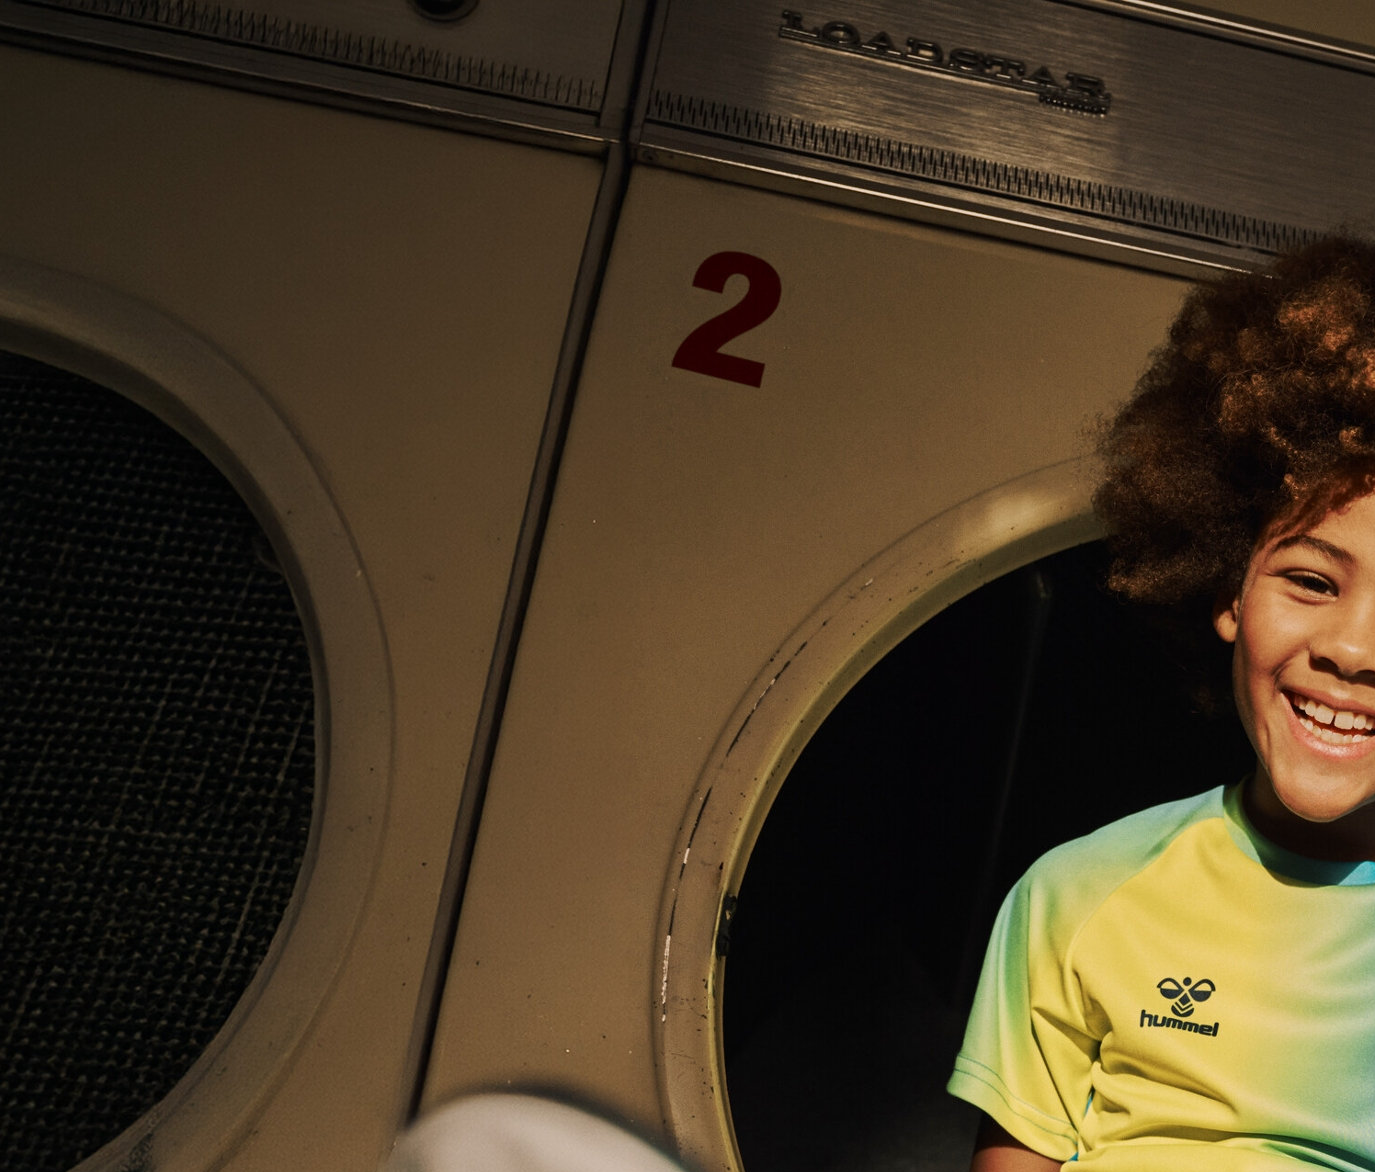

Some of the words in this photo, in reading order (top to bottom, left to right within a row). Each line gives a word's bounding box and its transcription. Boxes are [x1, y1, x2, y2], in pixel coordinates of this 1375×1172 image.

[779, 10, 1111, 101] LOADSTAR
[672, 251, 782, 388] 2
[1139, 1009, 1219, 1037] hummel
